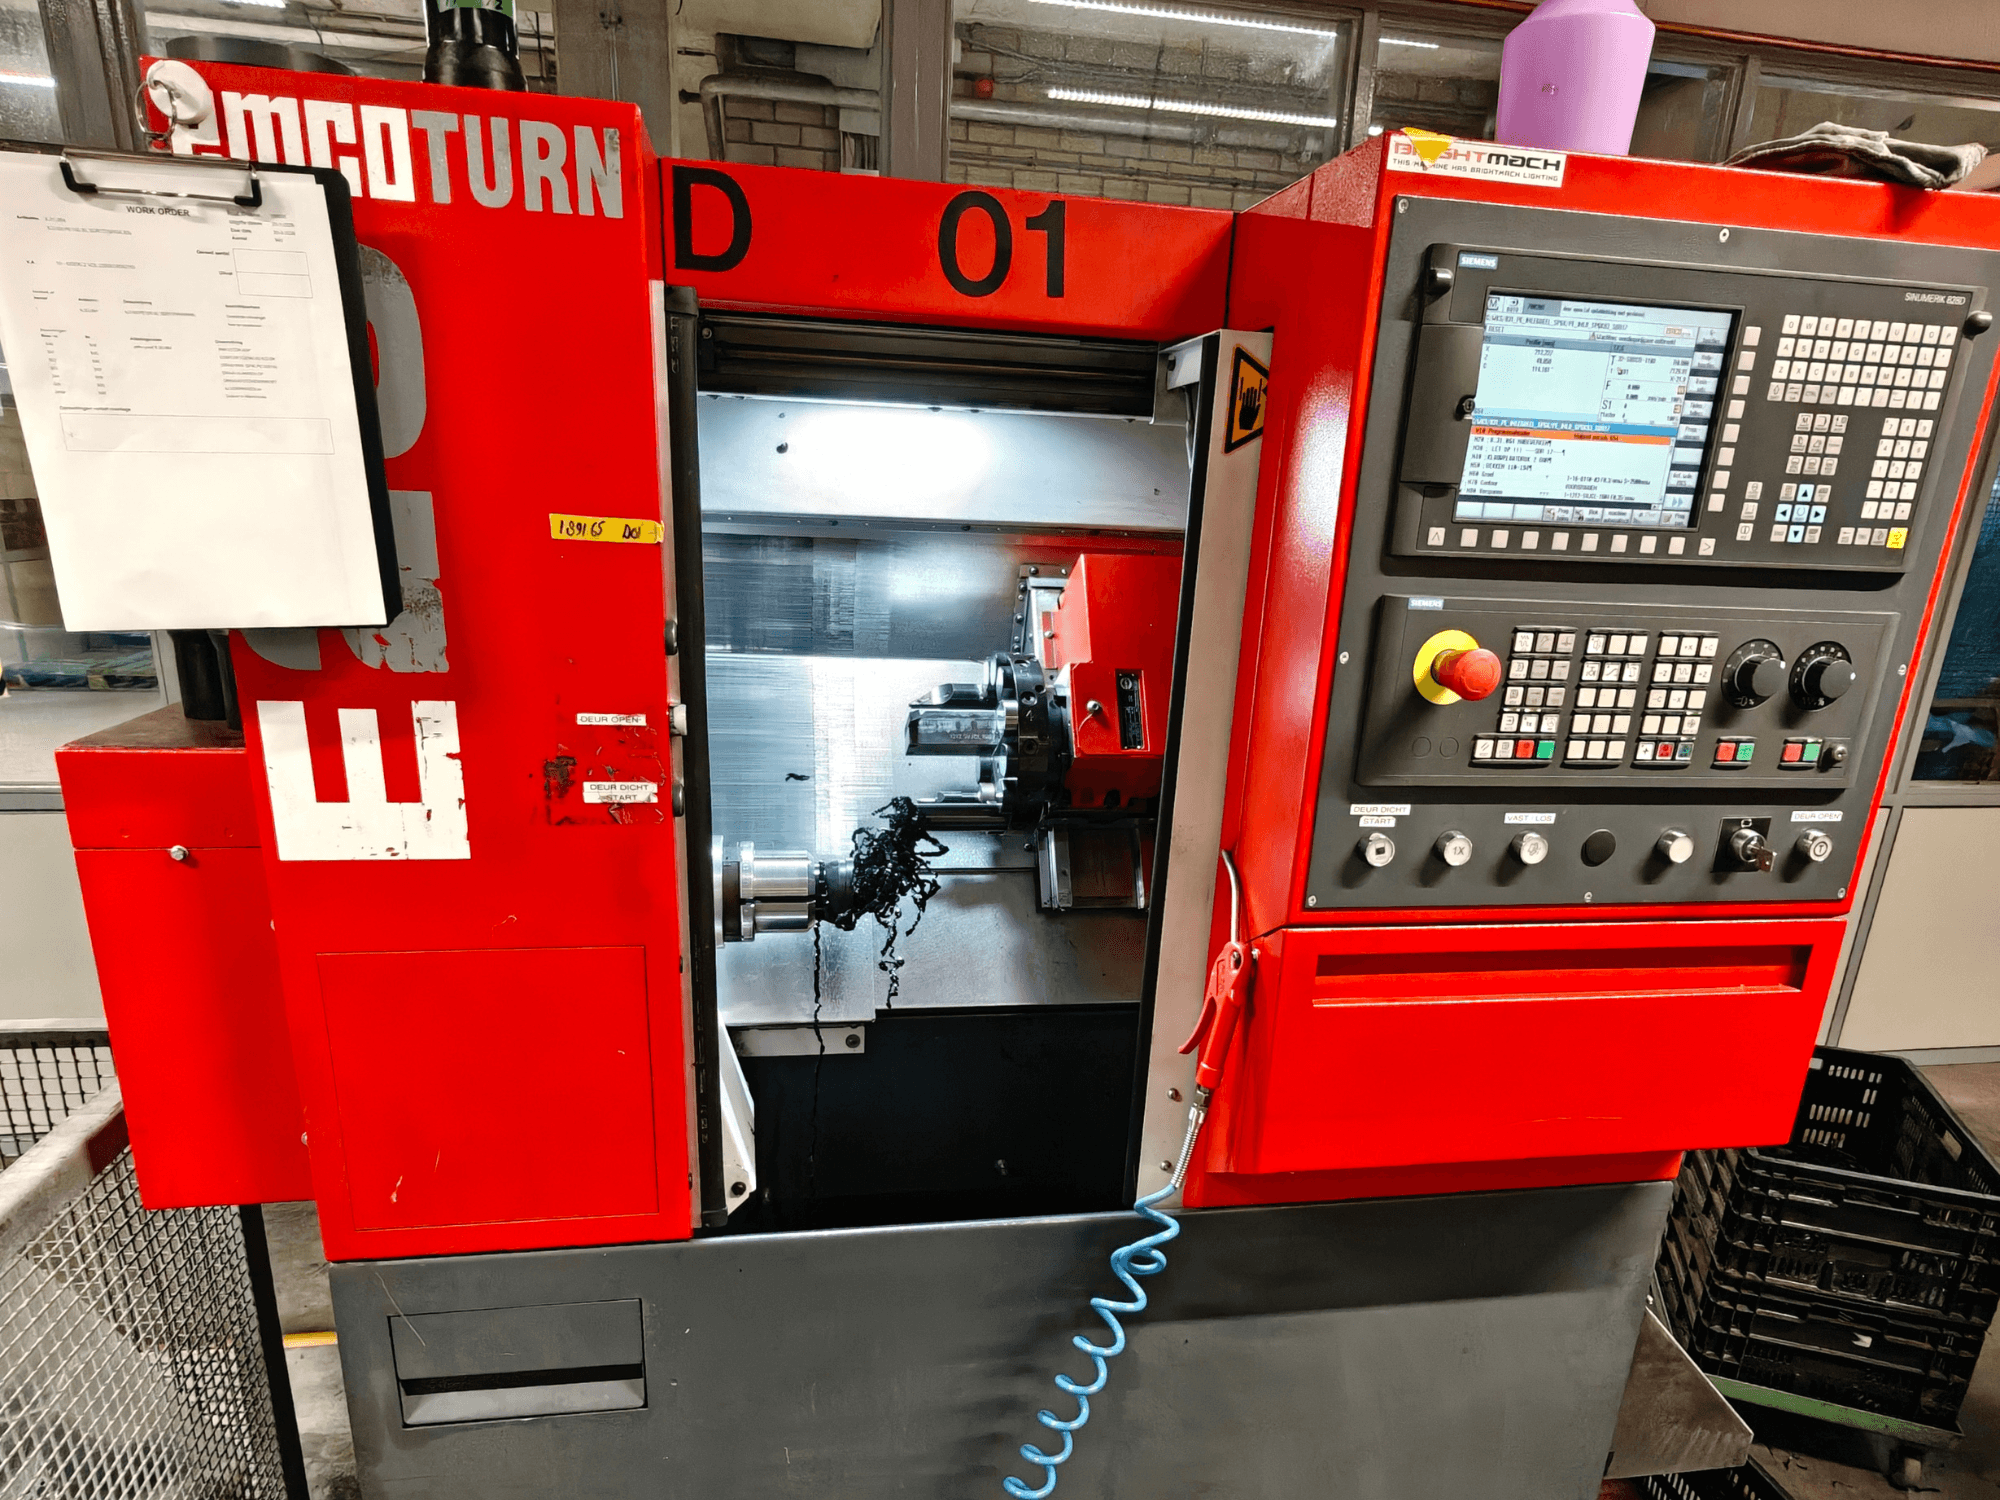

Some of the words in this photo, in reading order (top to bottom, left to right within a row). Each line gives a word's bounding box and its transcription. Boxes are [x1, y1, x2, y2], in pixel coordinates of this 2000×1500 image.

[1393, 158, 1411, 166] THIS
[1452, 164, 1467, 172] HAS
[1470, 166, 1520, 178] BRIGHTMACH
[1523, 172, 1559, 182] LIGHTING
[126, 205, 157, 215] WORK
[158, 207, 190, 217] ORDER
[673, 165, 752, 273] D
[938, 191, 1067, 298] 01
[1461, 255, 1497, 268] SIEMENS
[1905, 292, 1945, 304] SINUMERIK
[1601, 399, 1612, 410] S1
[580, 716, 608, 724] DEUR
[611, 716, 640, 724] OPEN
[590, 783, 617, 791] DEUR
[620, 783, 649, 792] DICHT
[1353, 806, 1379, 814] DEUR
[1381, 806, 1407, 814] DICHT
[1507, 814, 1526, 822] VAST
[1818, 812, 1842, 820] OPEN
[1453, 846, 1464, 856] 1X
